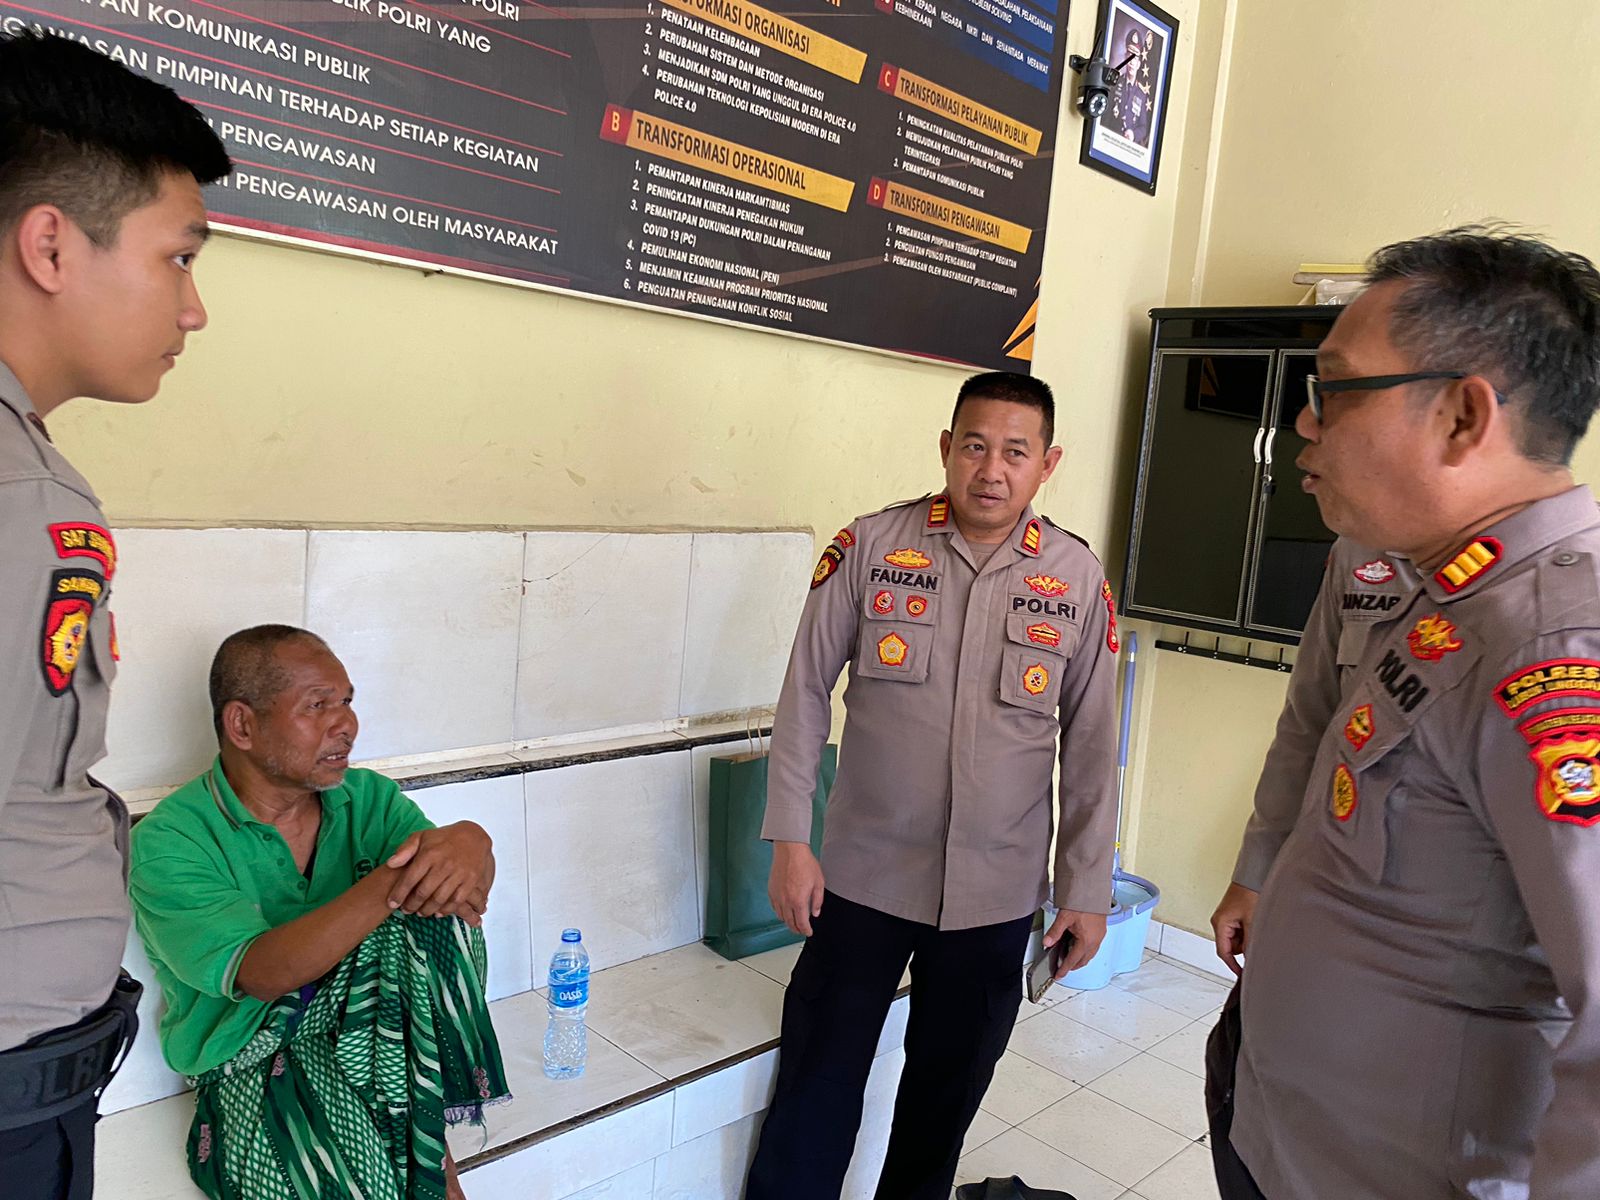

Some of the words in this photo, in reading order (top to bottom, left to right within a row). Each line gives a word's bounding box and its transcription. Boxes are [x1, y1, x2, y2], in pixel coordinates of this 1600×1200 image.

[148, 2, 297, 63] KOMUNIKASI
[304, 48, 371, 84] PUBLIK
[378, 2, 431, 34] POLRI
[437, 20, 491, 53] YANG
[648, 3, 654, 15] 1.
[661, 8, 704, 34] PENATAAN
[704, 26, 760, 58] KELEMBAGAAN
[745, 11, 810, 55] ORGANISASI
[982, 32, 994, 46] DAN
[645, 22, 653, 36] 2.
[660, 28, 708, 60] PERUBAHAN
[710, 44, 737, 68] SISTEM
[739, 58, 754, 74] DAN
[755, 66, 784, 86] METODE
[784, 76, 824, 102] ORGANISASI
[884, 70, 891, 88] C
[156, 55, 272, 103] PIMPINAN
[279, 88, 385, 131] TERHADAP
[389, 118, 449, 148] SETIAP
[453, 135, 539, 173] KEGIATAN
[642, 64, 650, 77] 4.
[656, 69, 705, 96] PERUBAHAN
[706, 86, 748, 112] TEKNOLOGI
[750, 103, 790, 127] KEPOLISIAN
[792, 119, 818, 138] MODERN
[820, 128, 828, 141] DI
[828, 132, 841, 144] ERA
[644, 44, 650, 56] 3.
[658, 48, 710, 78] MENJADIKAN
[711, 66, 728, 84] SDM
[728, 72, 750, 93] POLRI
[752, 82, 772, 101] YANG
[772, 91, 800, 112] UNGGUL
[801, 102, 809, 115] DI
[810, 106, 823, 120] ERA
[824, 111, 846, 130] POLICE
[847, 120, 856, 133] 4.0
[654, 88, 684, 109] POLICE
[684, 99, 697, 114] 4.0
[900, 76, 960, 117] TRANSFORMASI
[961, 104, 1003, 135] PELAYANAN
[1004, 122, 1028, 146] PUBLIK
[611, 110, 620, 132] B
[221, 121, 376, 174] PENGAWASAN
[636, 118, 730, 166] TRANSFORMASI
[732, 150, 806, 190] OPERASIONAL
[632, 180, 640, 192] 2.
[646, 182, 702, 208] PENINGKATAN
[703, 200, 734, 219] KINERJA
[736, 208, 779, 230] PENEGAKAN
[780, 220, 804, 236] HUKUM
[635, 160, 642, 172] 1.
[648, 162, 702, 189] PEMANTAPAN
[702, 180, 734, 198] KINERJA
[735, 188, 790, 214] HARKAMTIBMAS
[873, 184, 880, 200] D
[236, 172, 386, 220] PENGAWASAN
[392, 206, 439, 230] OLEH
[445, 216, 558, 255] MASYARAKAT
[630, 200, 638, 212] 3.
[644, 202, 698, 226] PEMANTAPAN
[698, 218, 740, 238] DUKUNGAN
[741, 229, 762, 244] POLRI
[763, 234, 786, 250] DALAM
[786, 240, 832, 261] PENANGANAN
[643, 222, 668, 239] COVID
[670, 230, 679, 242] 19
[680, 230, 697, 248] (PC)
[890, 188, 950, 224] TRANSFORMASI
[950, 210, 1000, 240] PENGAWASAN
[625, 258, 632, 270] 5.
[639, 261, 682, 280] MENJAMIN
[683, 271, 725, 290] KEAMANAN
[726, 280, 760, 298] PROGRAM
[760, 288, 796, 306] PRIORITAS
[796, 296, 828, 312] NASIONAL
[627, 240, 634, 251] 4.
[640, 242, 687, 262] PEMULIHAN
[688, 252, 723, 272] EKONOMI
[724, 262, 760, 280] NASIONAL
[760, 271, 780, 286] (PEN)
[624, 278, 631, 290] 6.
[638, 280, 686, 301] PENGUATAN
[687, 290, 736, 312] PENANGANAN
[738, 302, 768, 318] KONFLIK
[769, 308, 792, 322] SOSIAL
[870, 567, 938, 590] FAUZAN
[1012, 597, 1076, 620] POLRI
[1506, 665, 1600, 696] POLRES
